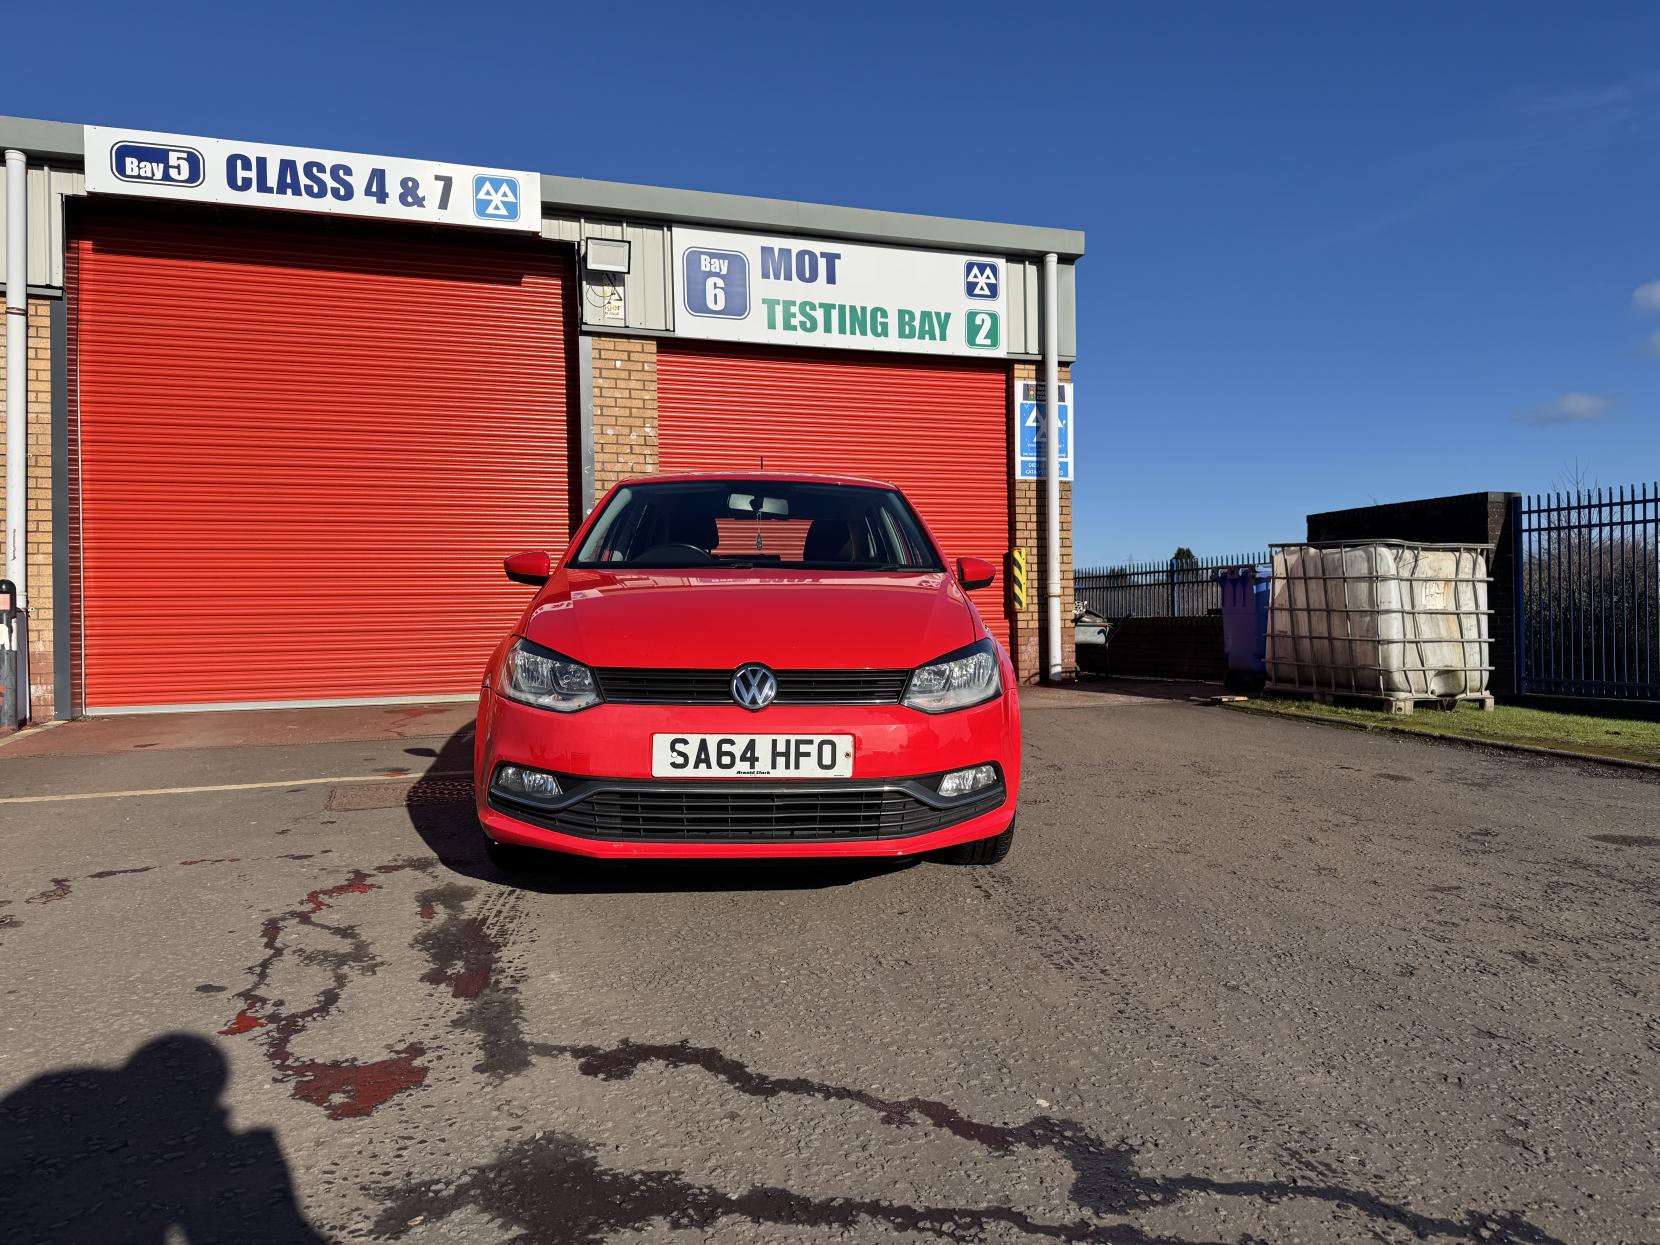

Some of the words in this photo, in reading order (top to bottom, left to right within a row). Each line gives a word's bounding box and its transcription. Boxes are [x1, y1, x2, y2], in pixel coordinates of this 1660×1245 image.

[125, 156, 163, 181] Bay
[168, 151, 190, 181] 5
[225, 153, 354, 202] CLASS
[364, 168, 389, 204] 4
[398, 176, 426, 209] &
[434, 174, 454, 210] 7
[700, 254, 729, 275] Bay
[760, 245, 841, 285] MOT
[705, 276, 726, 311] 6
[762, 298, 889, 338] TESTING
[897, 308, 952, 342] BAY
[974, 313, 992, 345] 2
[669, 737, 759, 770] SA64
[770, 738, 837, 770] HFO
